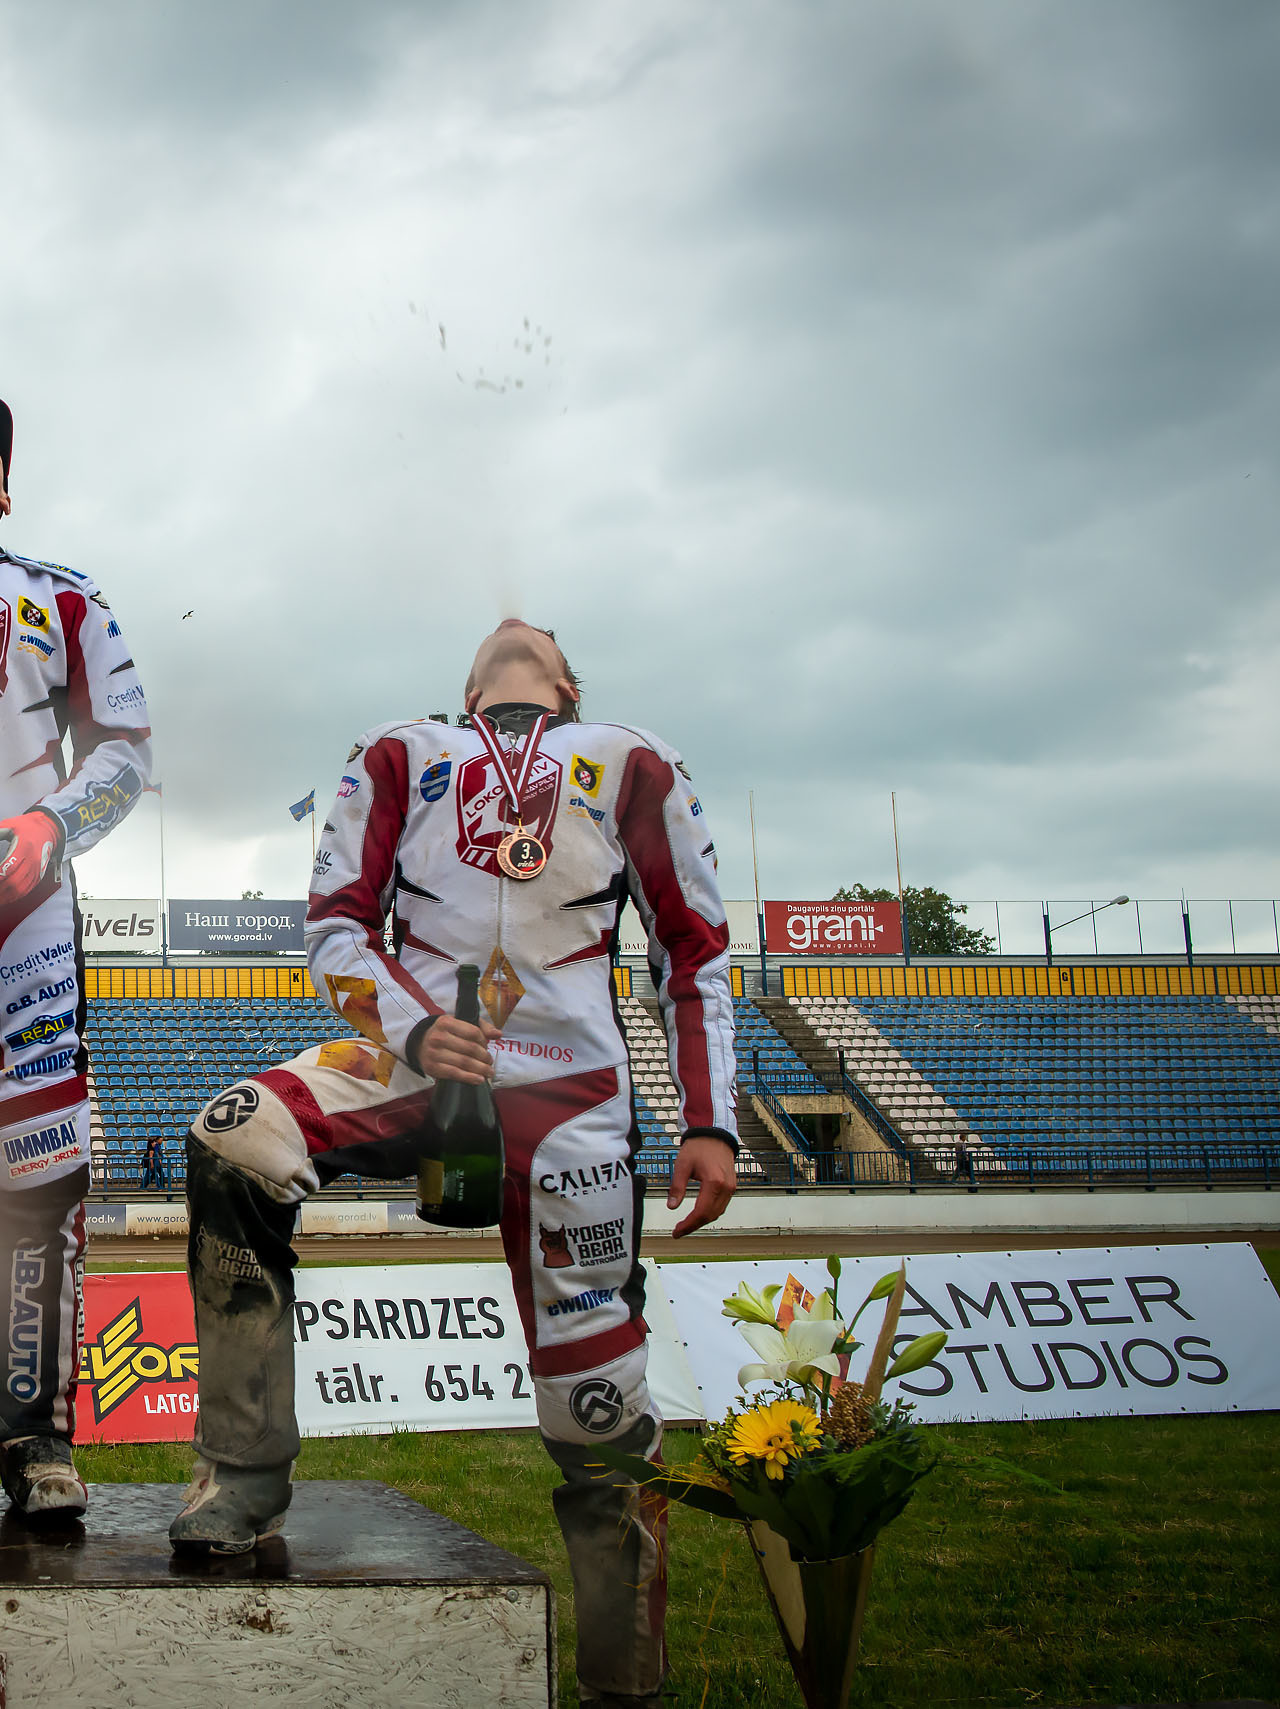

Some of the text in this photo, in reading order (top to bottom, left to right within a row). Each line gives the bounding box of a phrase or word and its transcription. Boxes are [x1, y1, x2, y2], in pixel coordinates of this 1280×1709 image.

[184, 911, 296, 931] Наш город.
[787, 905, 829, 914] Daugavpils
[81, 913, 155, 937] ivels
[208, 932, 273, 943] www.gorod.lv
[0, 941, 75, 980] CreditValue
[38, 976, 76, 1003] AUTO
[292, 972, 300, 983] K
[21, 1018, 68, 1045] REALL
[494, 1039, 574, 1063] STUDIOS
[3, 1120, 77, 1164] UMMBA!
[10, 1146, 80, 1178] ENERGY DRINK
[311, 1213, 377, 1226] www.gorod.lv
[577, 1237, 625, 1259] BEAR
[579, 1252, 629, 1268] GASTROBARS
[892, 1275, 1199, 1331] AMBER
[291, 1298, 505, 1343] PSARDZES
[889, 1334, 1231, 1397] STUDIOS
[315, 1363, 400, 1404] tālr.
[424, 1364, 495, 1402] 654
